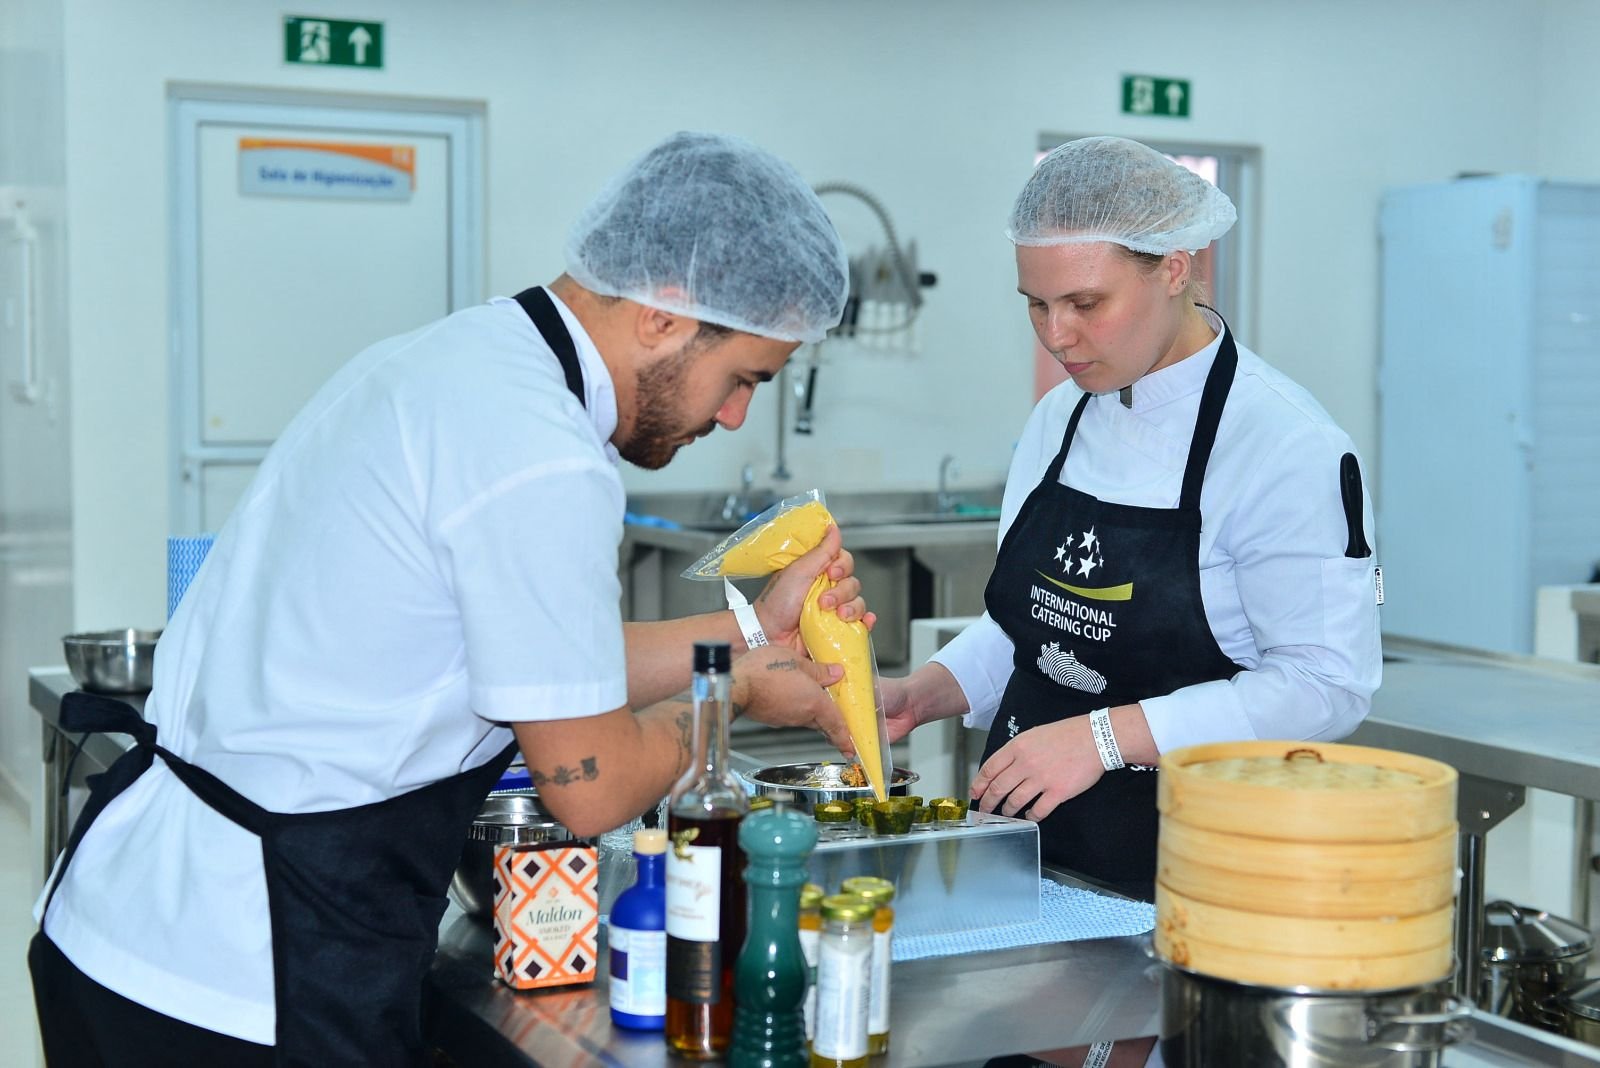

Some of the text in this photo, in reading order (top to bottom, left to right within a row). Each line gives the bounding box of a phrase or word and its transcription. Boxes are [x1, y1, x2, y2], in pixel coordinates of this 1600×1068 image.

[293, 168, 307, 181] de
[1030, 585, 1117, 628] INTERNATIONAL
[1031, 604, 1112, 642] CATERING CUP
[1097, 716, 1105, 730] COPA
[526, 906, 583, 926] Maldon
